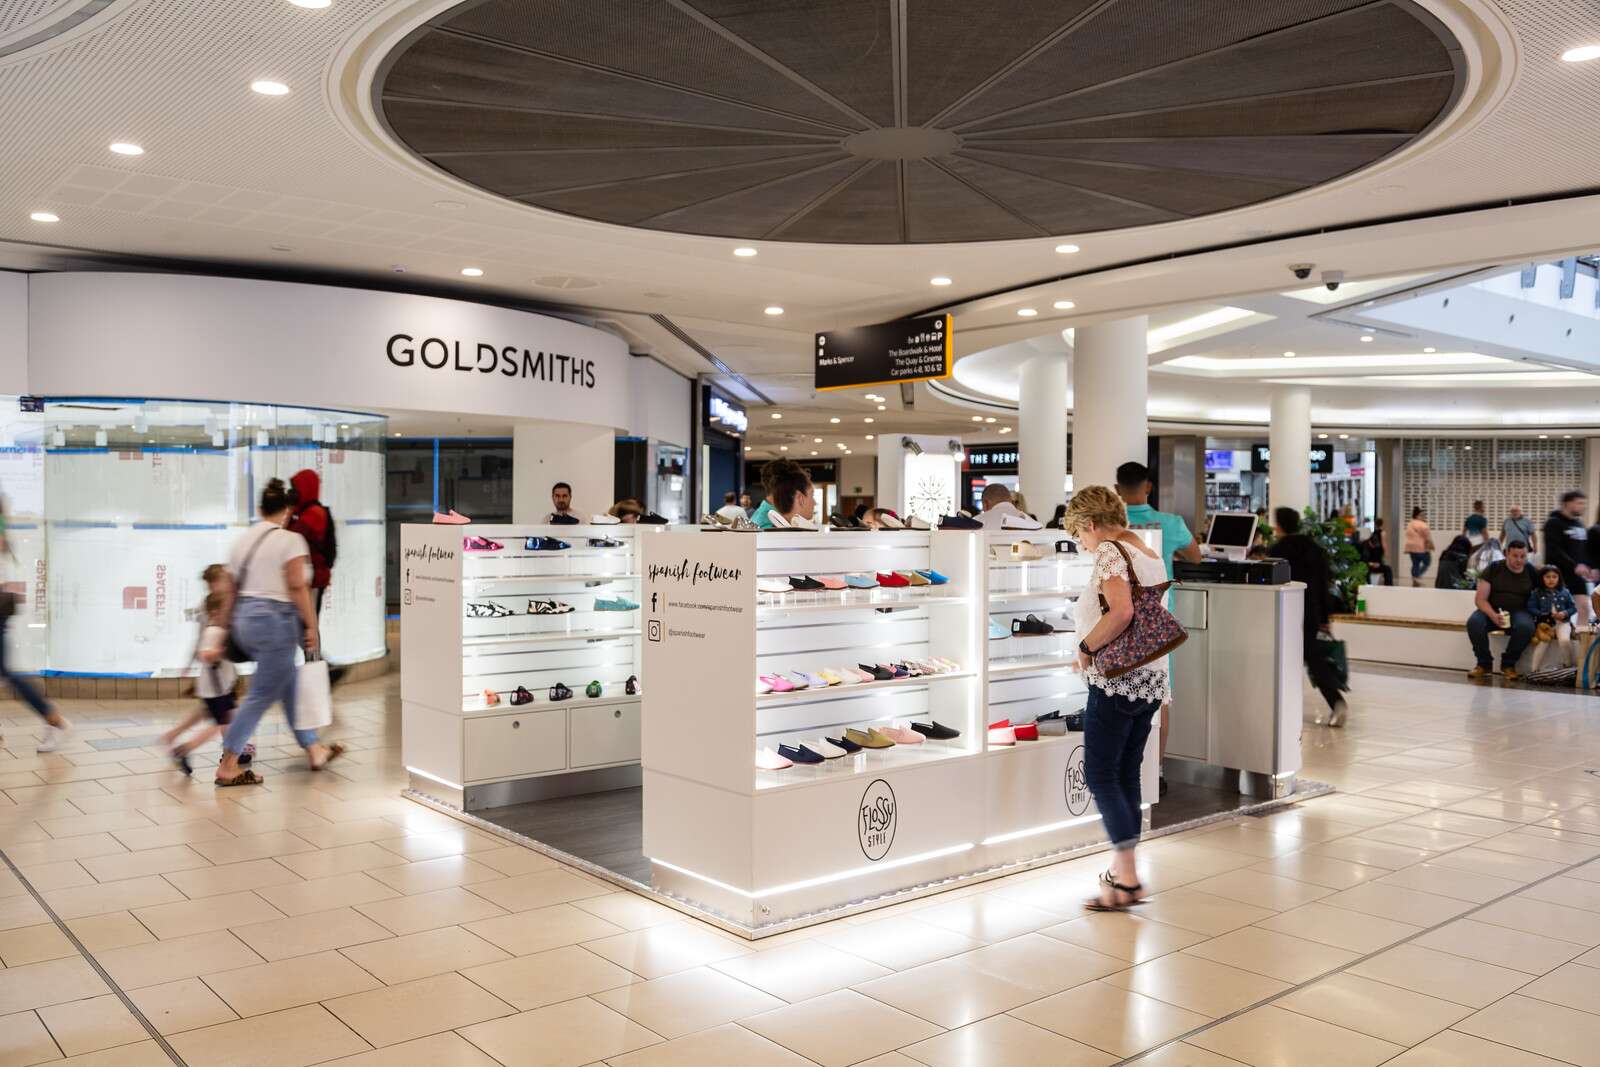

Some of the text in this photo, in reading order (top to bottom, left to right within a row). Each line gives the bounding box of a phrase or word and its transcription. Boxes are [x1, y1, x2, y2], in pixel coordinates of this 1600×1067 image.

[899, 346, 923, 356] Boardwalk
[929, 344, 943, 353] Hotel
[386, 333, 596, 389] GOLDSMITHS
[896, 358, 905, 366] The
[905, 357, 919, 366] Quay
[923, 355, 943, 363] Cinema
[890, 368, 899, 376] Car
[900, 367, 913, 376] parks
[970, 454, 988, 464] THE
[648, 558, 743, 586] spanish footwear
